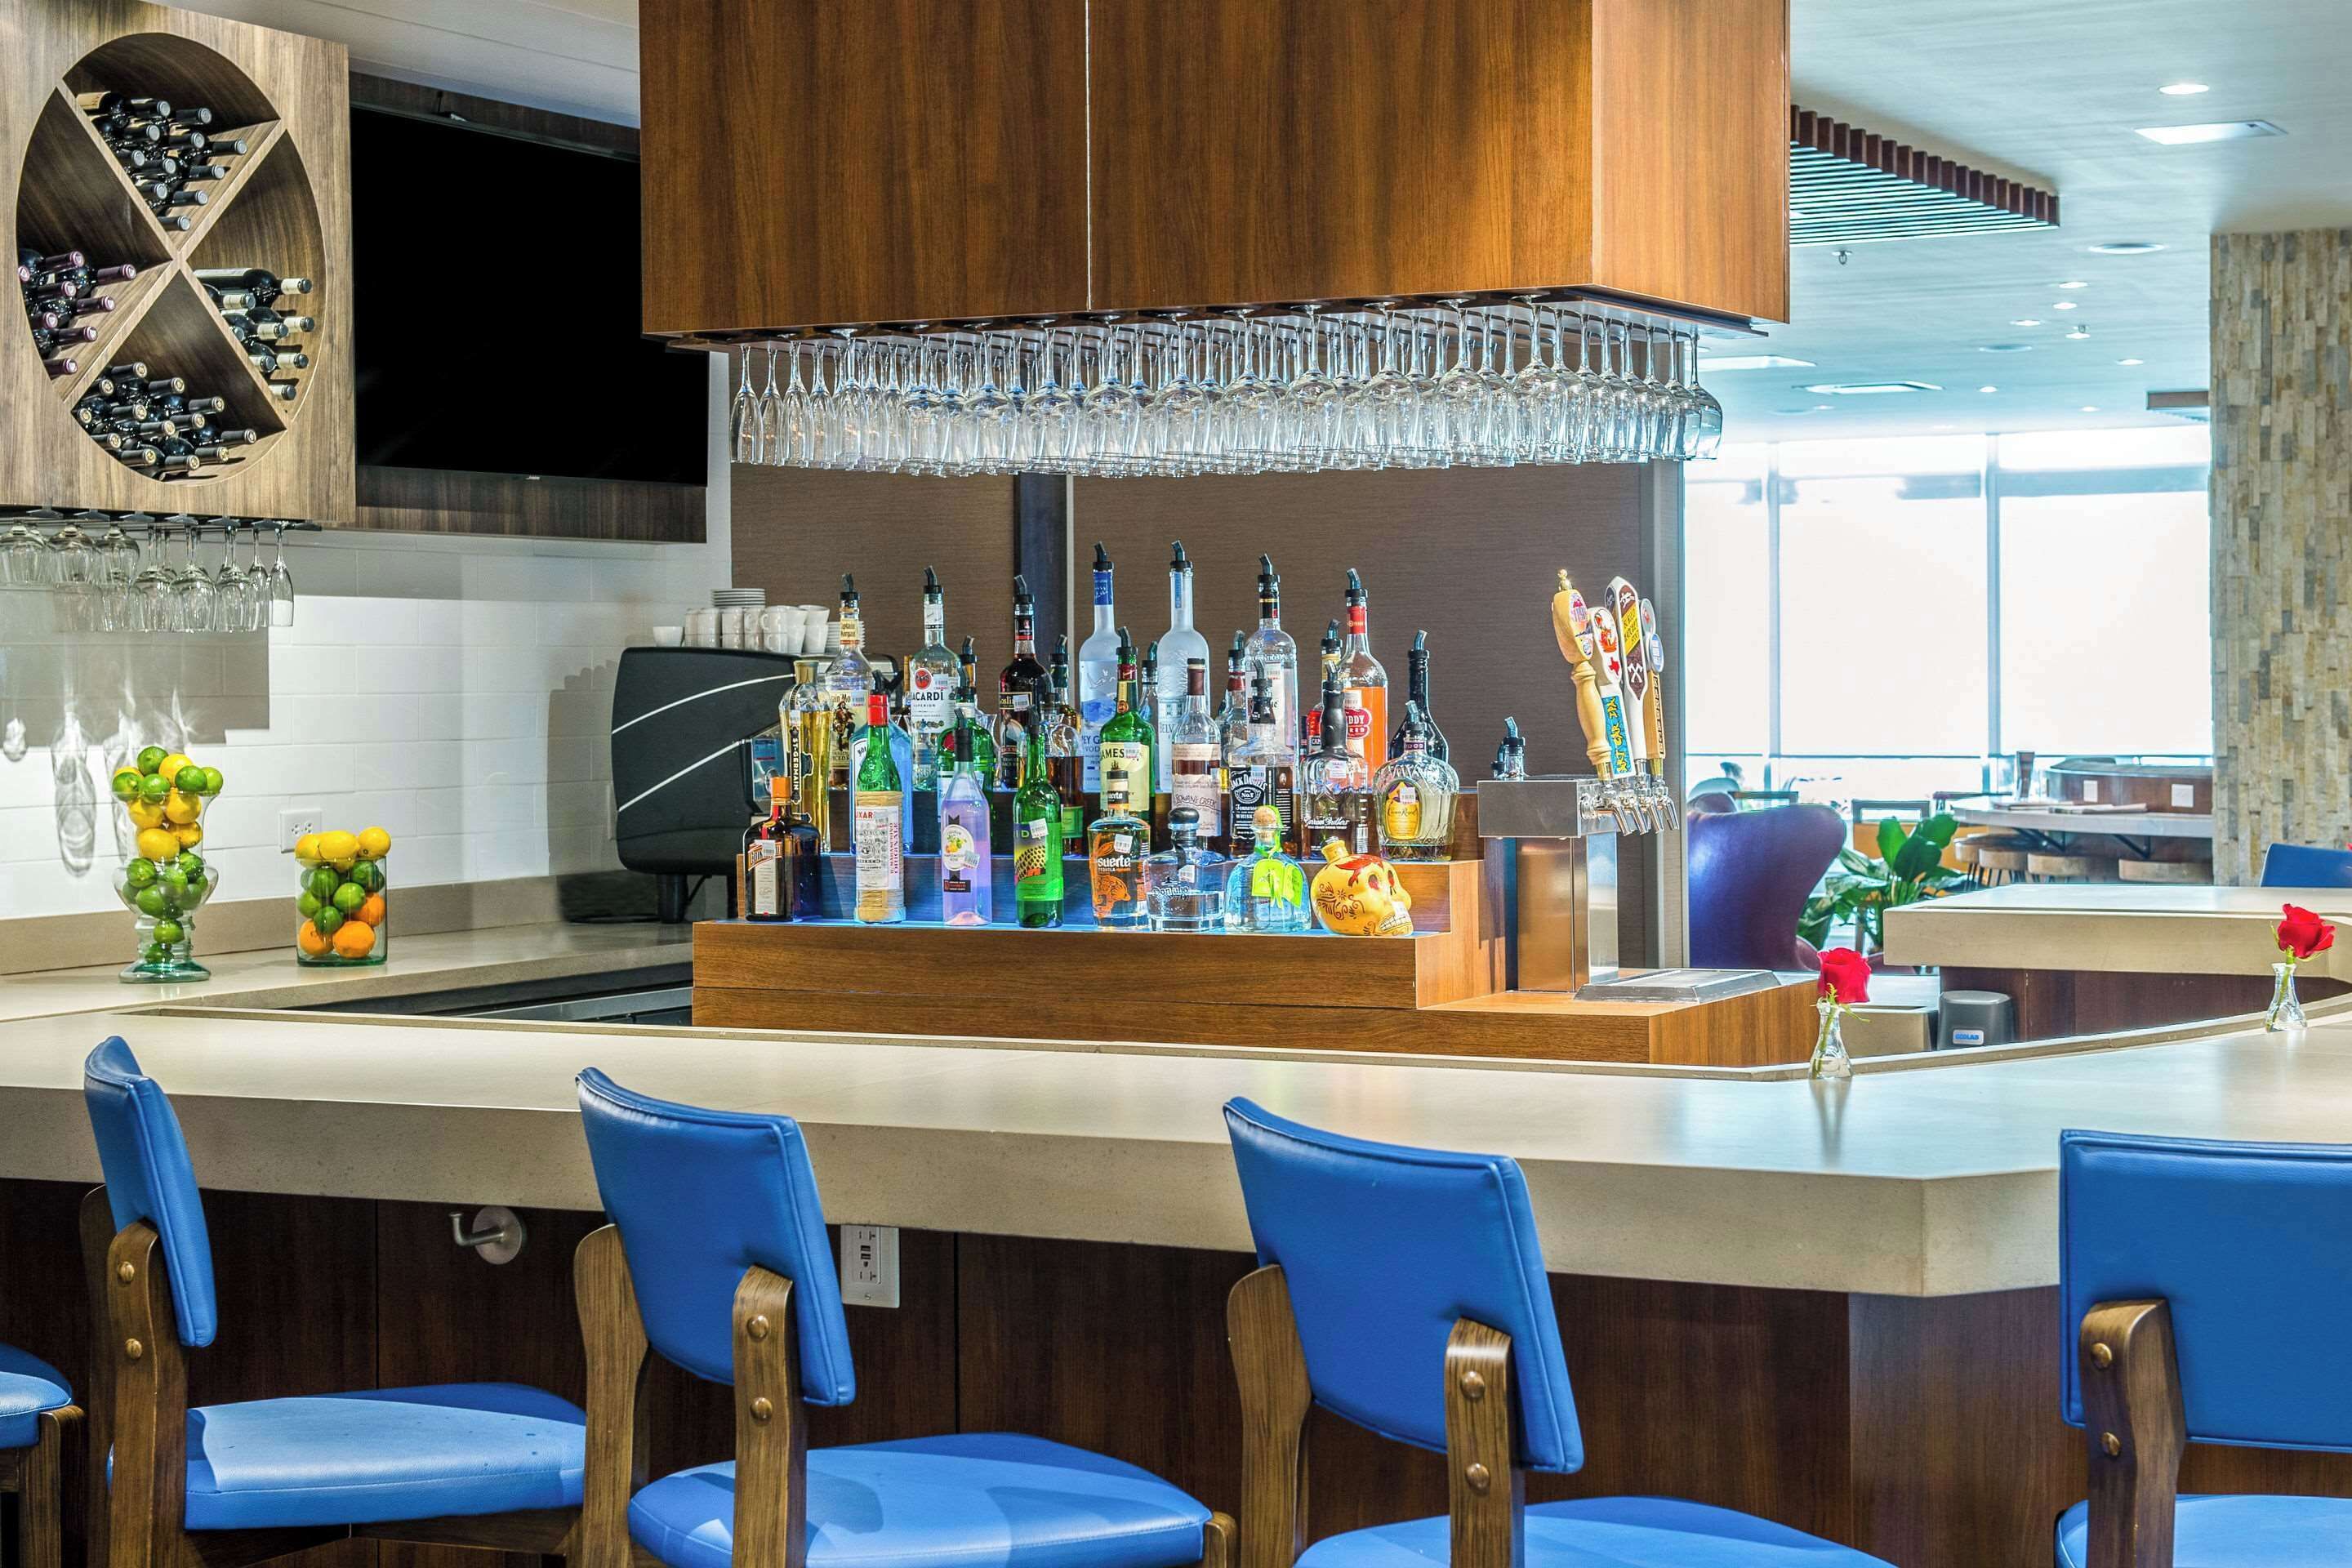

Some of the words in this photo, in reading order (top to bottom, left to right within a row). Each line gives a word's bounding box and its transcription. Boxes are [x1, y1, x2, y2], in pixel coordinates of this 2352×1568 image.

[1607, 697, 1619, 719] IPA
[1348, 715, 1365, 724] DDY
[1083, 736, 1091, 744] EY
[1610, 721, 1624, 746] CAR
[1102, 747, 1125, 759] AMES
[1615, 750, 1628, 773] ART
[1231, 777, 1243, 791] JACK
[1098, 855, 1131, 867] suerte
